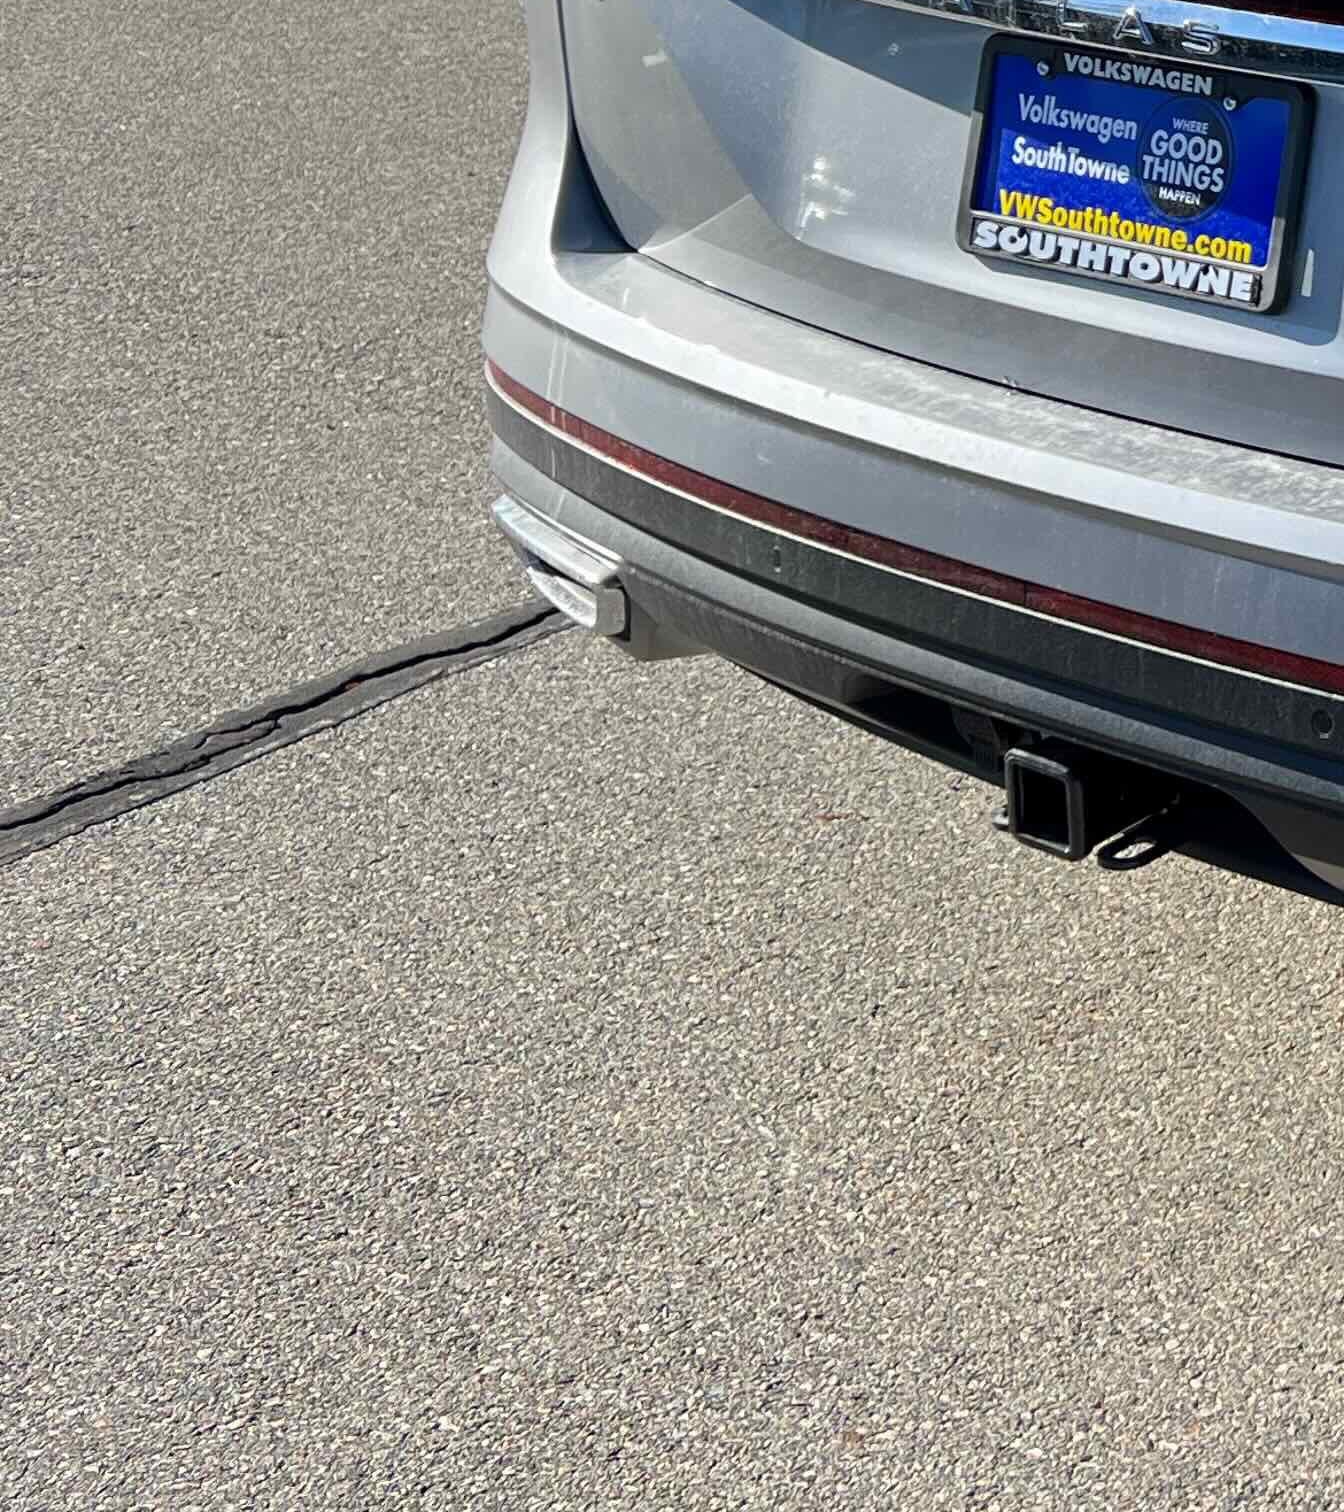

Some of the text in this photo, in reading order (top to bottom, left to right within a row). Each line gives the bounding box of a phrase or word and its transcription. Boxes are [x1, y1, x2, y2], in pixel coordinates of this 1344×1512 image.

[1063, 52, 1214, 96] VOLKSWAGEN
[1018, 92, 1138, 144] Volkswagen
[1172, 117, 1209, 136] WHERE
[1150, 129, 1223, 165] GOOD
[1142, 154, 1225, 194] THINGS
[1158, 186, 1201, 207] HAPPEN
[998, 188, 1253, 264] VWSouthtowne.com
[973, 222, 1258, 303] SOUTHTOWNE
